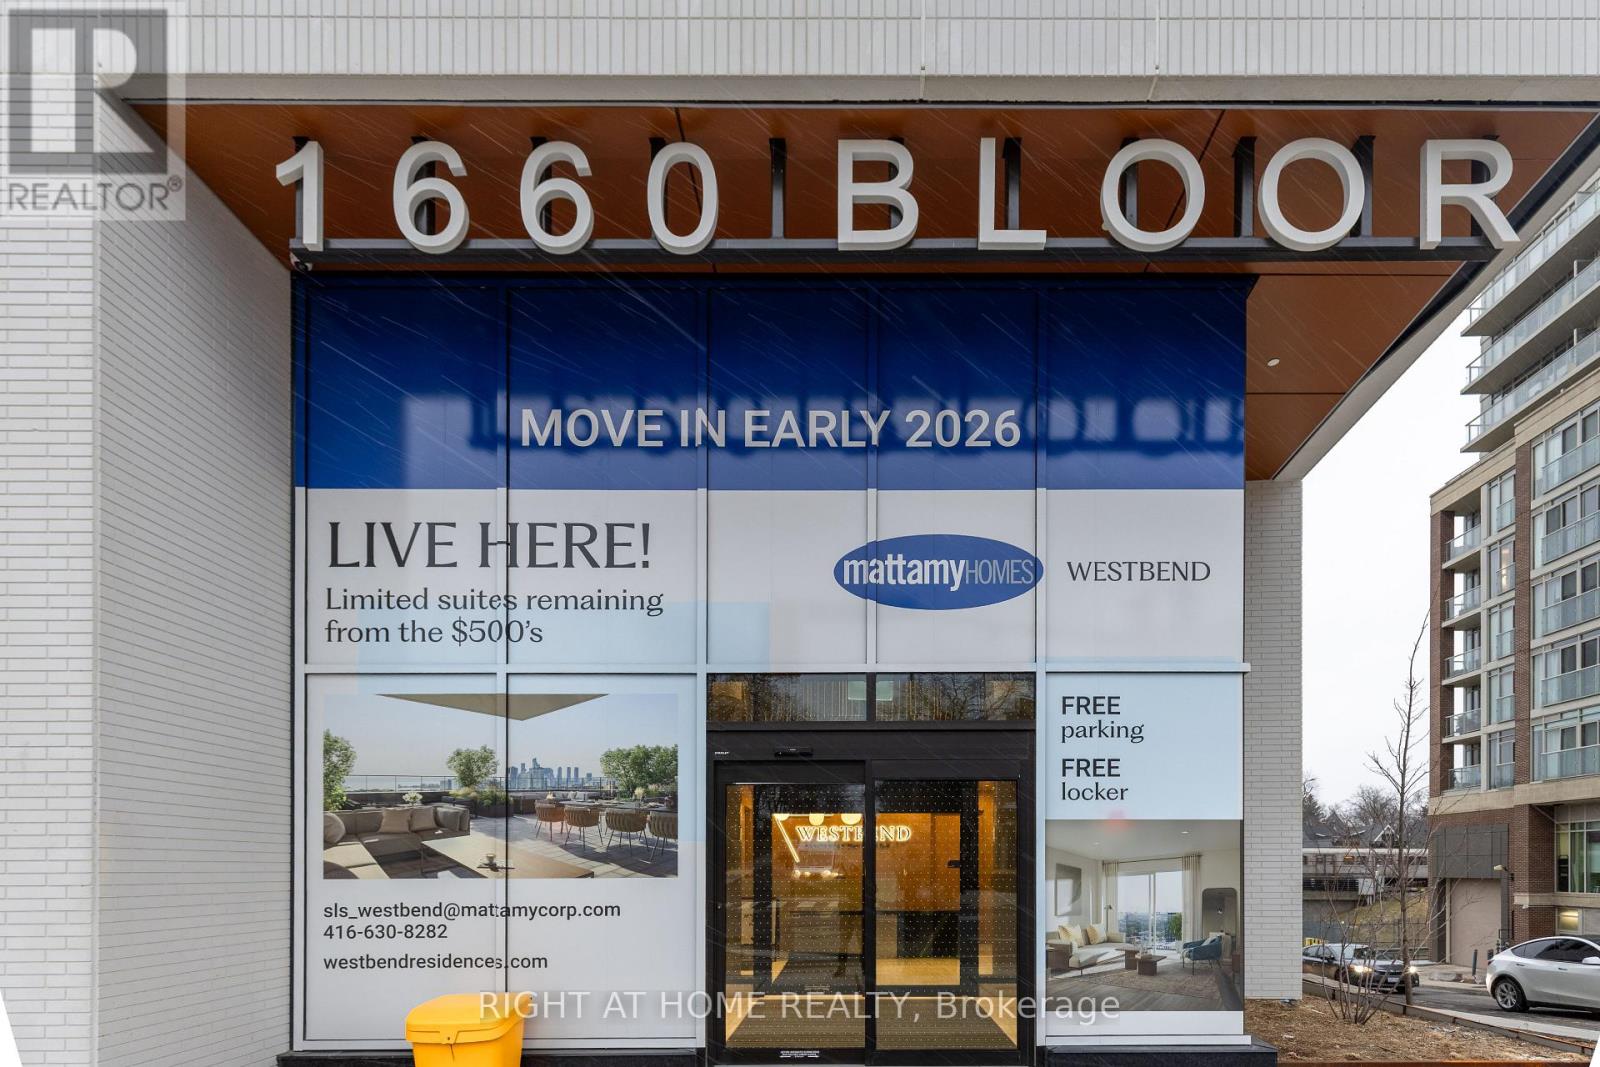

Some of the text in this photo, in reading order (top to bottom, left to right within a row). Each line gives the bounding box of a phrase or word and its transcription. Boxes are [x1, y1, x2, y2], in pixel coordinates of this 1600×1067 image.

[276, 137, 1521, 256] 1660 BLOOR
[520, 407, 1021, 448] MOVE IN EARLY 2026
[328, 521, 651, 569] LIVE HERE!
[1066, 560, 1212, 582] WESTBEND
[325, 586, 664, 617] Limited suites remaining
[324, 619, 391, 643] from
[398, 619, 443, 643] the
[1061, 695, 1121, 716] FREE
[1061, 719, 1145, 744] parking
[1061, 758, 1121, 778] FREE
[1061, 781, 1129, 801] locker
[795, 824, 912, 842] WESTBND
[323, 902, 621, 919] sls_westbend@mattamycorp.com
[323, 924, 448, 940] 416-630-8282
[323, 953, 548, 970] westbendresidences.com
